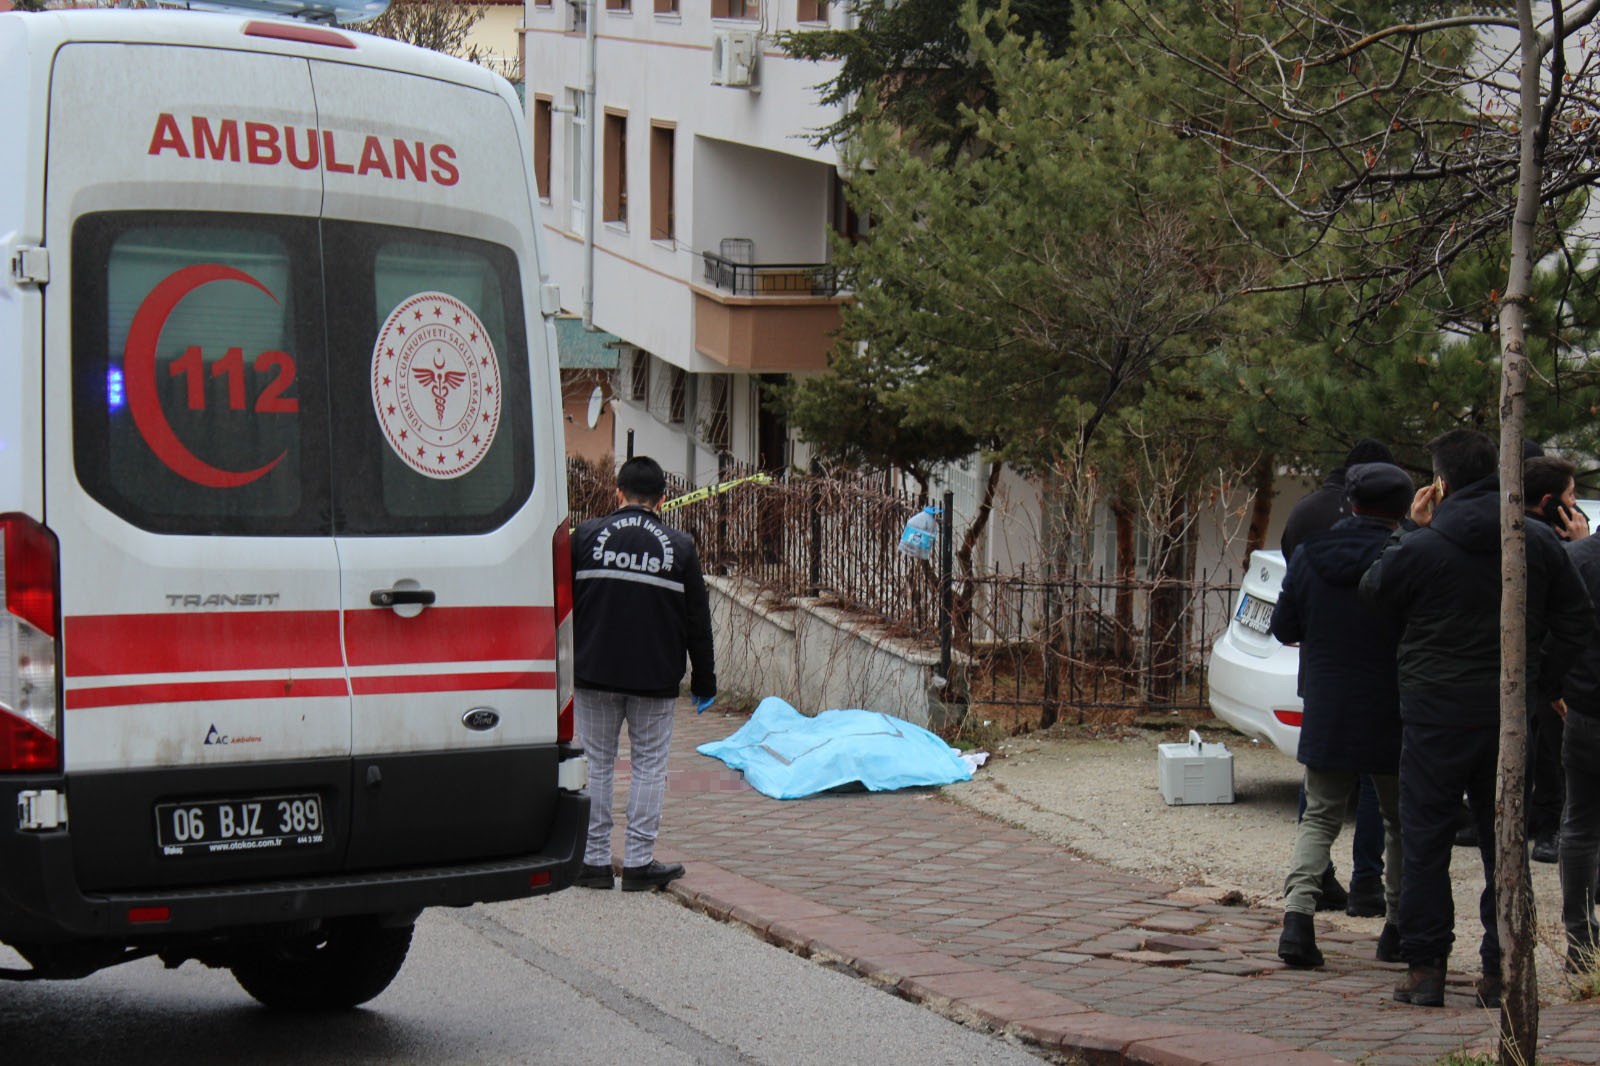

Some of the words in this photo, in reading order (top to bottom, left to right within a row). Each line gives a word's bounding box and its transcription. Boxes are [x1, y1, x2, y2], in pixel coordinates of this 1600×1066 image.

[148, 113, 460, 187] AMBULANS
[399, 327, 447, 378] CUMHURİYETİ
[449, 333, 474, 369] SAĞLIK
[169, 345, 299, 413] 112
[458, 372, 479, 434] BAKANLIĞI
[592, 527, 612, 561] OLAY
[603, 550, 661, 574] POLİS
[165, 593, 280, 607] TRANSIT
[173, 808, 205, 841] 06
[219, 803, 264, 838] BJZ
[278, 799, 319, 833] 389
